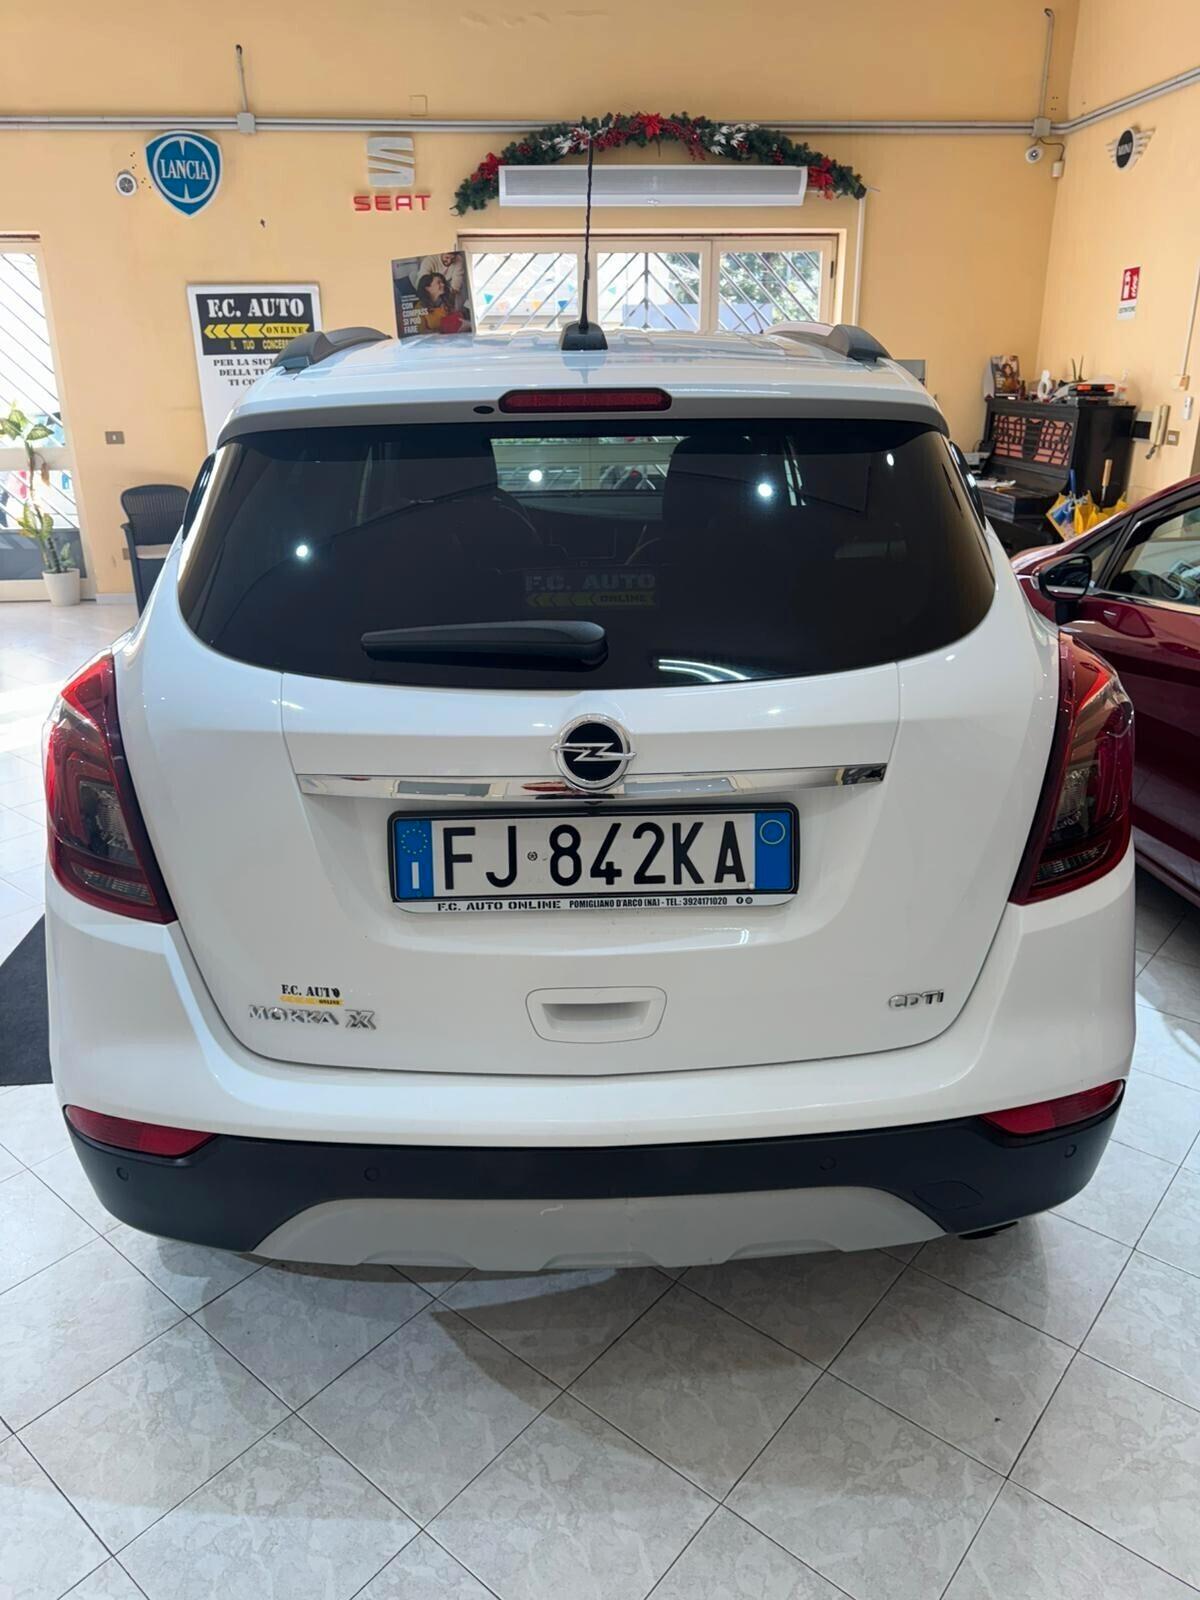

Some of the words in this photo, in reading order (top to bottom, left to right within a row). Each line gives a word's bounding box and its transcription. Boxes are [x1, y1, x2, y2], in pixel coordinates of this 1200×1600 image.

[160, 159, 210, 180] LANCIA
[354, 195, 431, 211] SEAT
[207, 299, 241, 318] F.C.
[248, 298, 304, 317] AUTO
[266, 326, 304, 335] ONLINE
[213, 358, 234, 367] PER
[237, 358, 249, 367] LA
[219, 368, 251, 377] DELLA
[525, 575, 571, 591] F.C.
[582, 574, 656, 590] AUTO
[600, 594, 648, 603] ONLINE
[443, 825, 517, 890] FJ
[549, 820, 746, 887] 842KA
[438, 902, 461, 911] F.C.
[466, 901, 503, 910] AUTO
[508, 900, 562, 910] ONLINE
[569, 899, 614, 908] POMIGLIANO
[616, 898, 642, 907] D'ARCO
[683, 896, 727, 906] 3924171020
[281, 984, 302, 996] F.C.
[306, 986, 340, 998] AUTO
[249, 1004, 339, 1026] MOKKA
[345, 1009, 377, 1030] X
